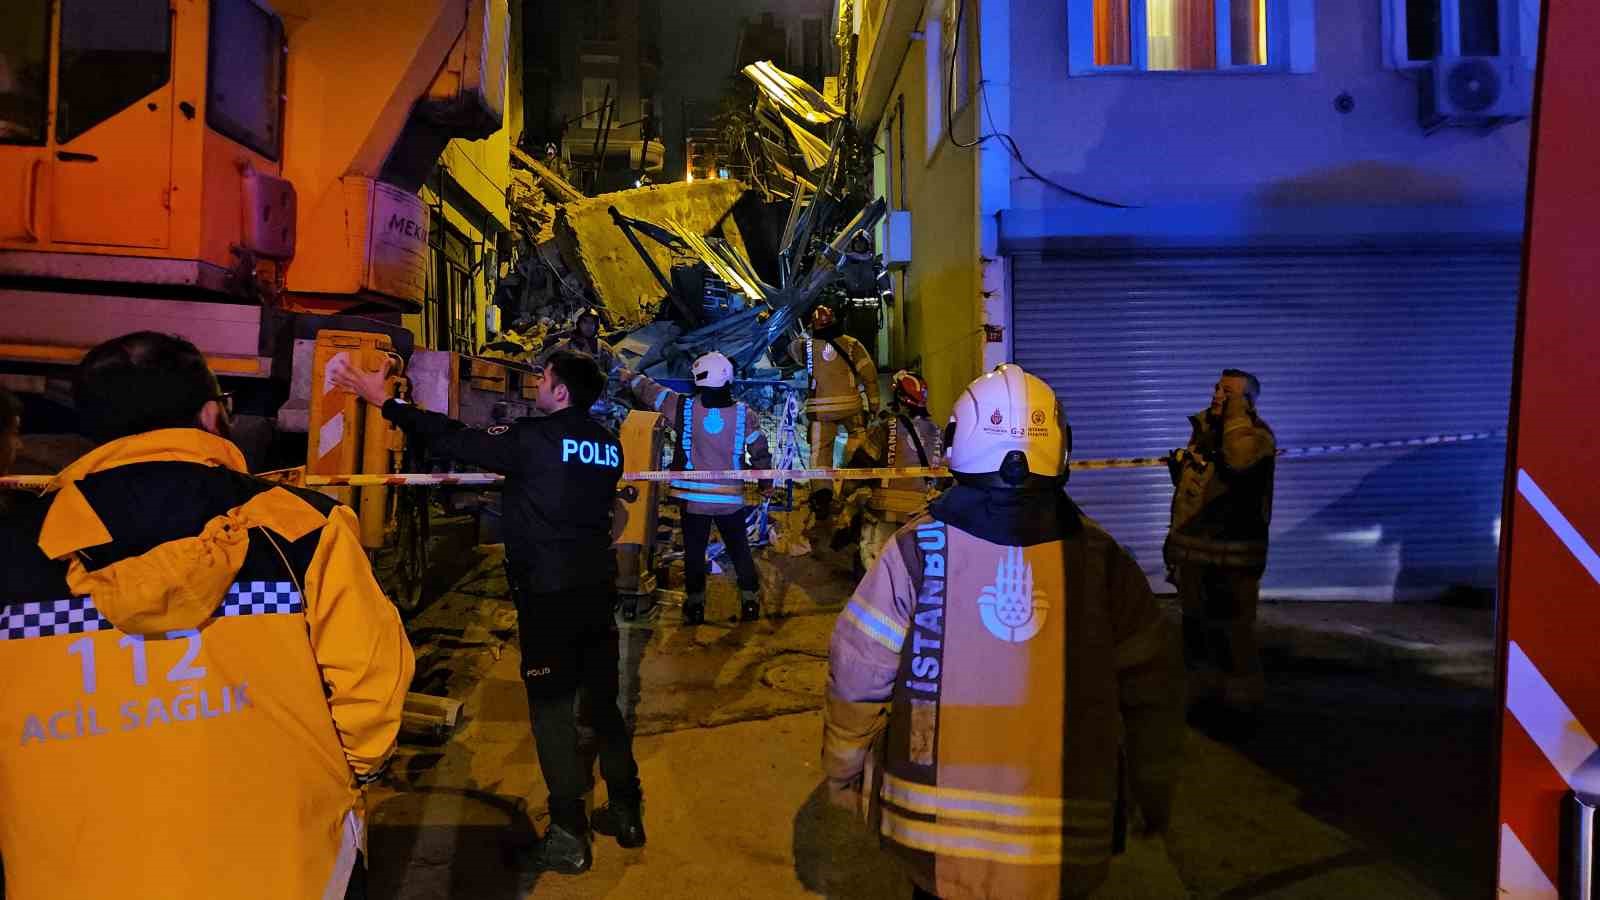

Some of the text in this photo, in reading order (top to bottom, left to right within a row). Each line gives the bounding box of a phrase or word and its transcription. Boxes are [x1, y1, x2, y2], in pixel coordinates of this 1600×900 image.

[66, 629, 208, 695] 112
[20, 680, 252, 746] ACİL SAĞLIK
